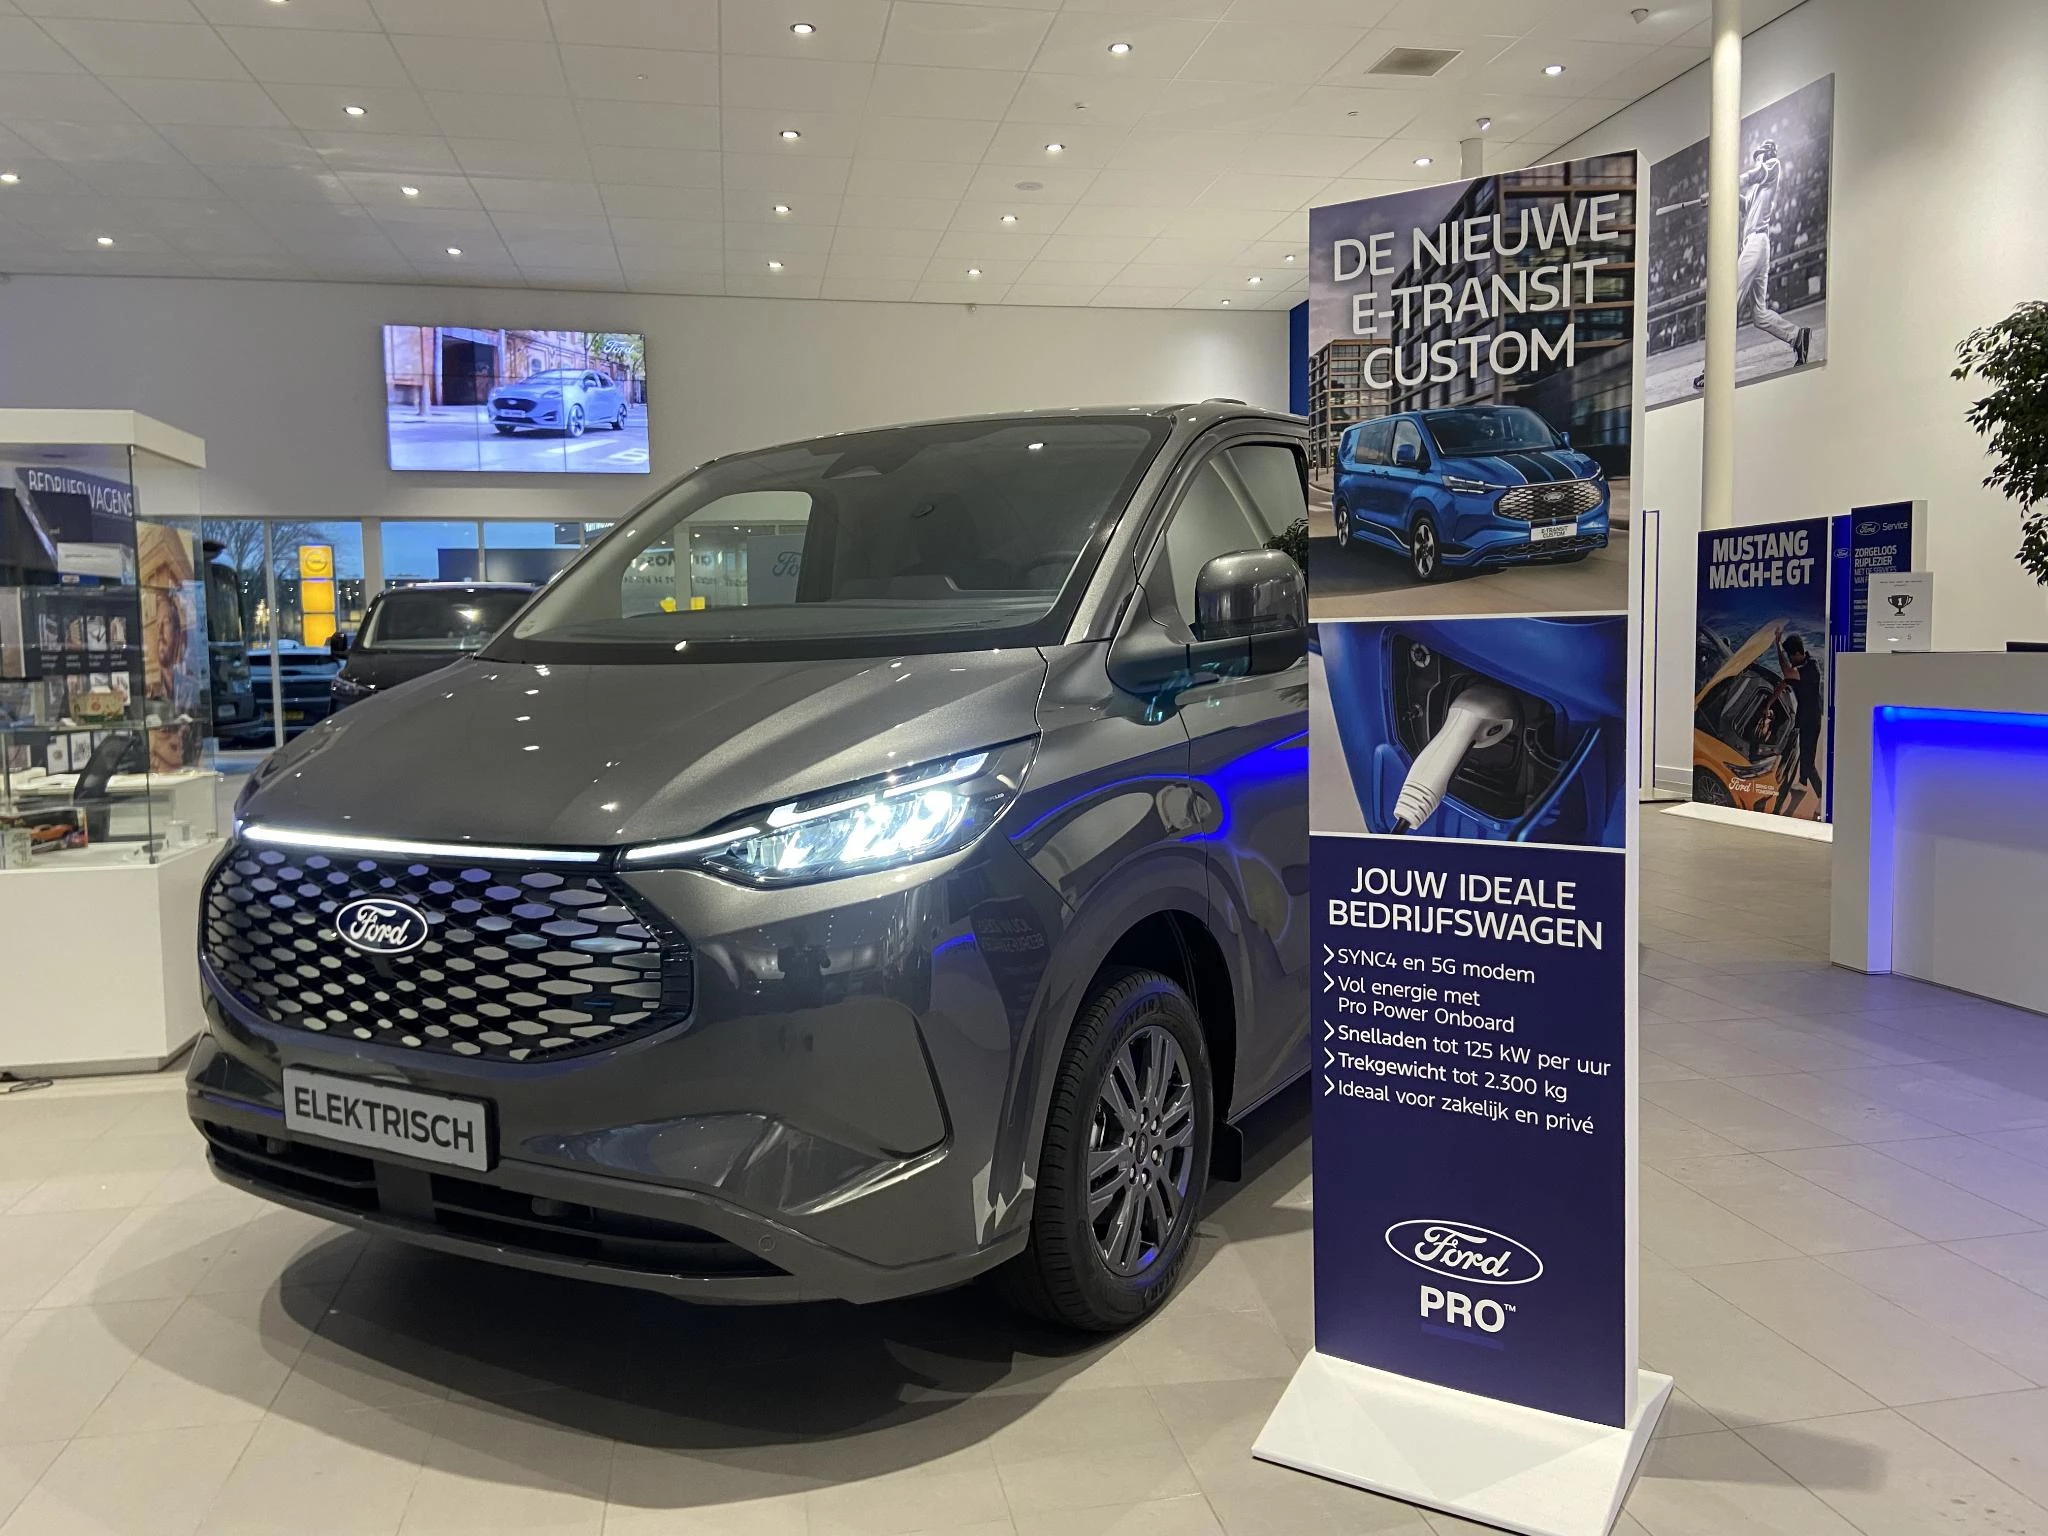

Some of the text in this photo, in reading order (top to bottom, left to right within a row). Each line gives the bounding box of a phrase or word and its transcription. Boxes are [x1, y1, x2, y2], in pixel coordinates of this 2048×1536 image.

[1333, 193, 1620, 282] DE NIEUWE
[1352, 257, 1608, 335] E-TRANSIT
[604, 340, 635, 353] Ford
[1364, 323, 1575, 390] CUSTOM
[1712, 529, 1808, 563] MUSTANG
[1882, 521, 1908, 531] Service
[1854, 545, 1897, 558] ZORGELOOS
[1709, 558, 1814, 590] MACH-E GT
[1729, 777, 1751, 792] Ford
[1350, 866, 1577, 911] JOUW IDEALE
[350, 905, 411, 945] Ford
[1328, 899, 1603, 950] BEDRIJFSWAGEN
[1337, 948, 1535, 984] SYNC4 en 5G modem
[1338, 975, 1480, 1007] Vol energie met
[1339, 997, 1514, 1033] Pro Power Onboard
[1337, 1025, 1611, 1076] Snelladen tot 125 kW per uur
[1337, 1051, 1567, 1102] Trekgewicht tot 2.300 kg
[295, 1086, 474, 1153] ELEKTRISCH
[1339, 1079, 1594, 1135] Ideaal voor zakelijk en privé
[1414, 1226, 1512, 1277] Ford
